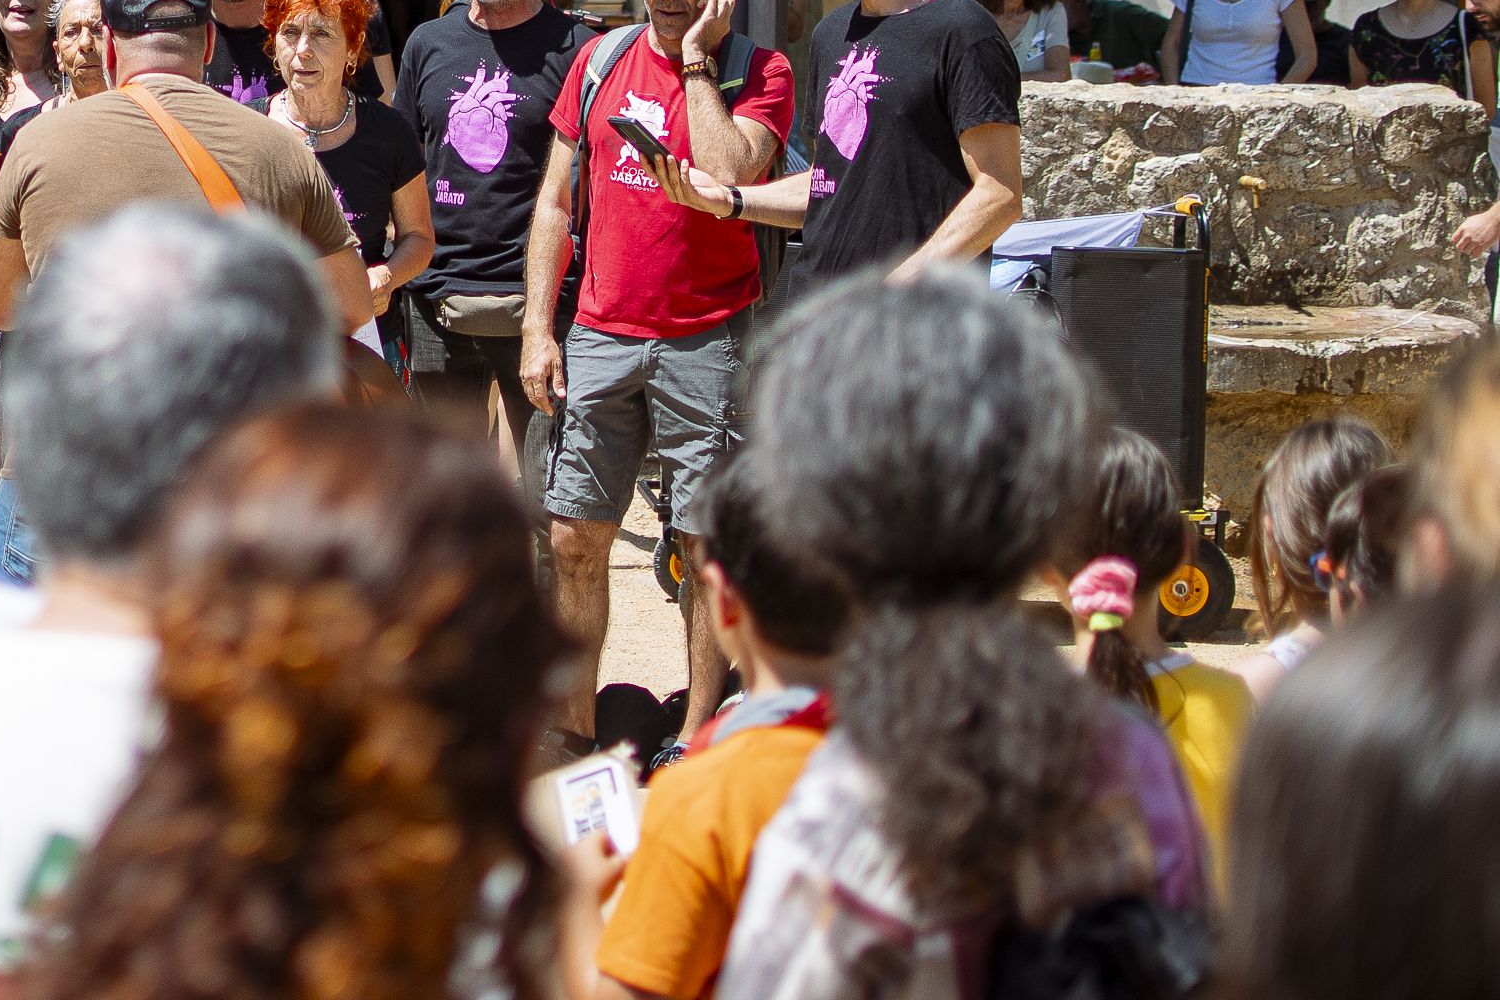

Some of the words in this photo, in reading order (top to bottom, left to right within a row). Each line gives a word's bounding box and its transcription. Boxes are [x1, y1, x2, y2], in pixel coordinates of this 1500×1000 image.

[622, 165, 646, 178] COR
[436, 180, 450, 192] COR
[610, 170, 659, 188] JABATO
[810, 180, 836, 194] JABATO
[435, 191, 465, 205] JABATO
